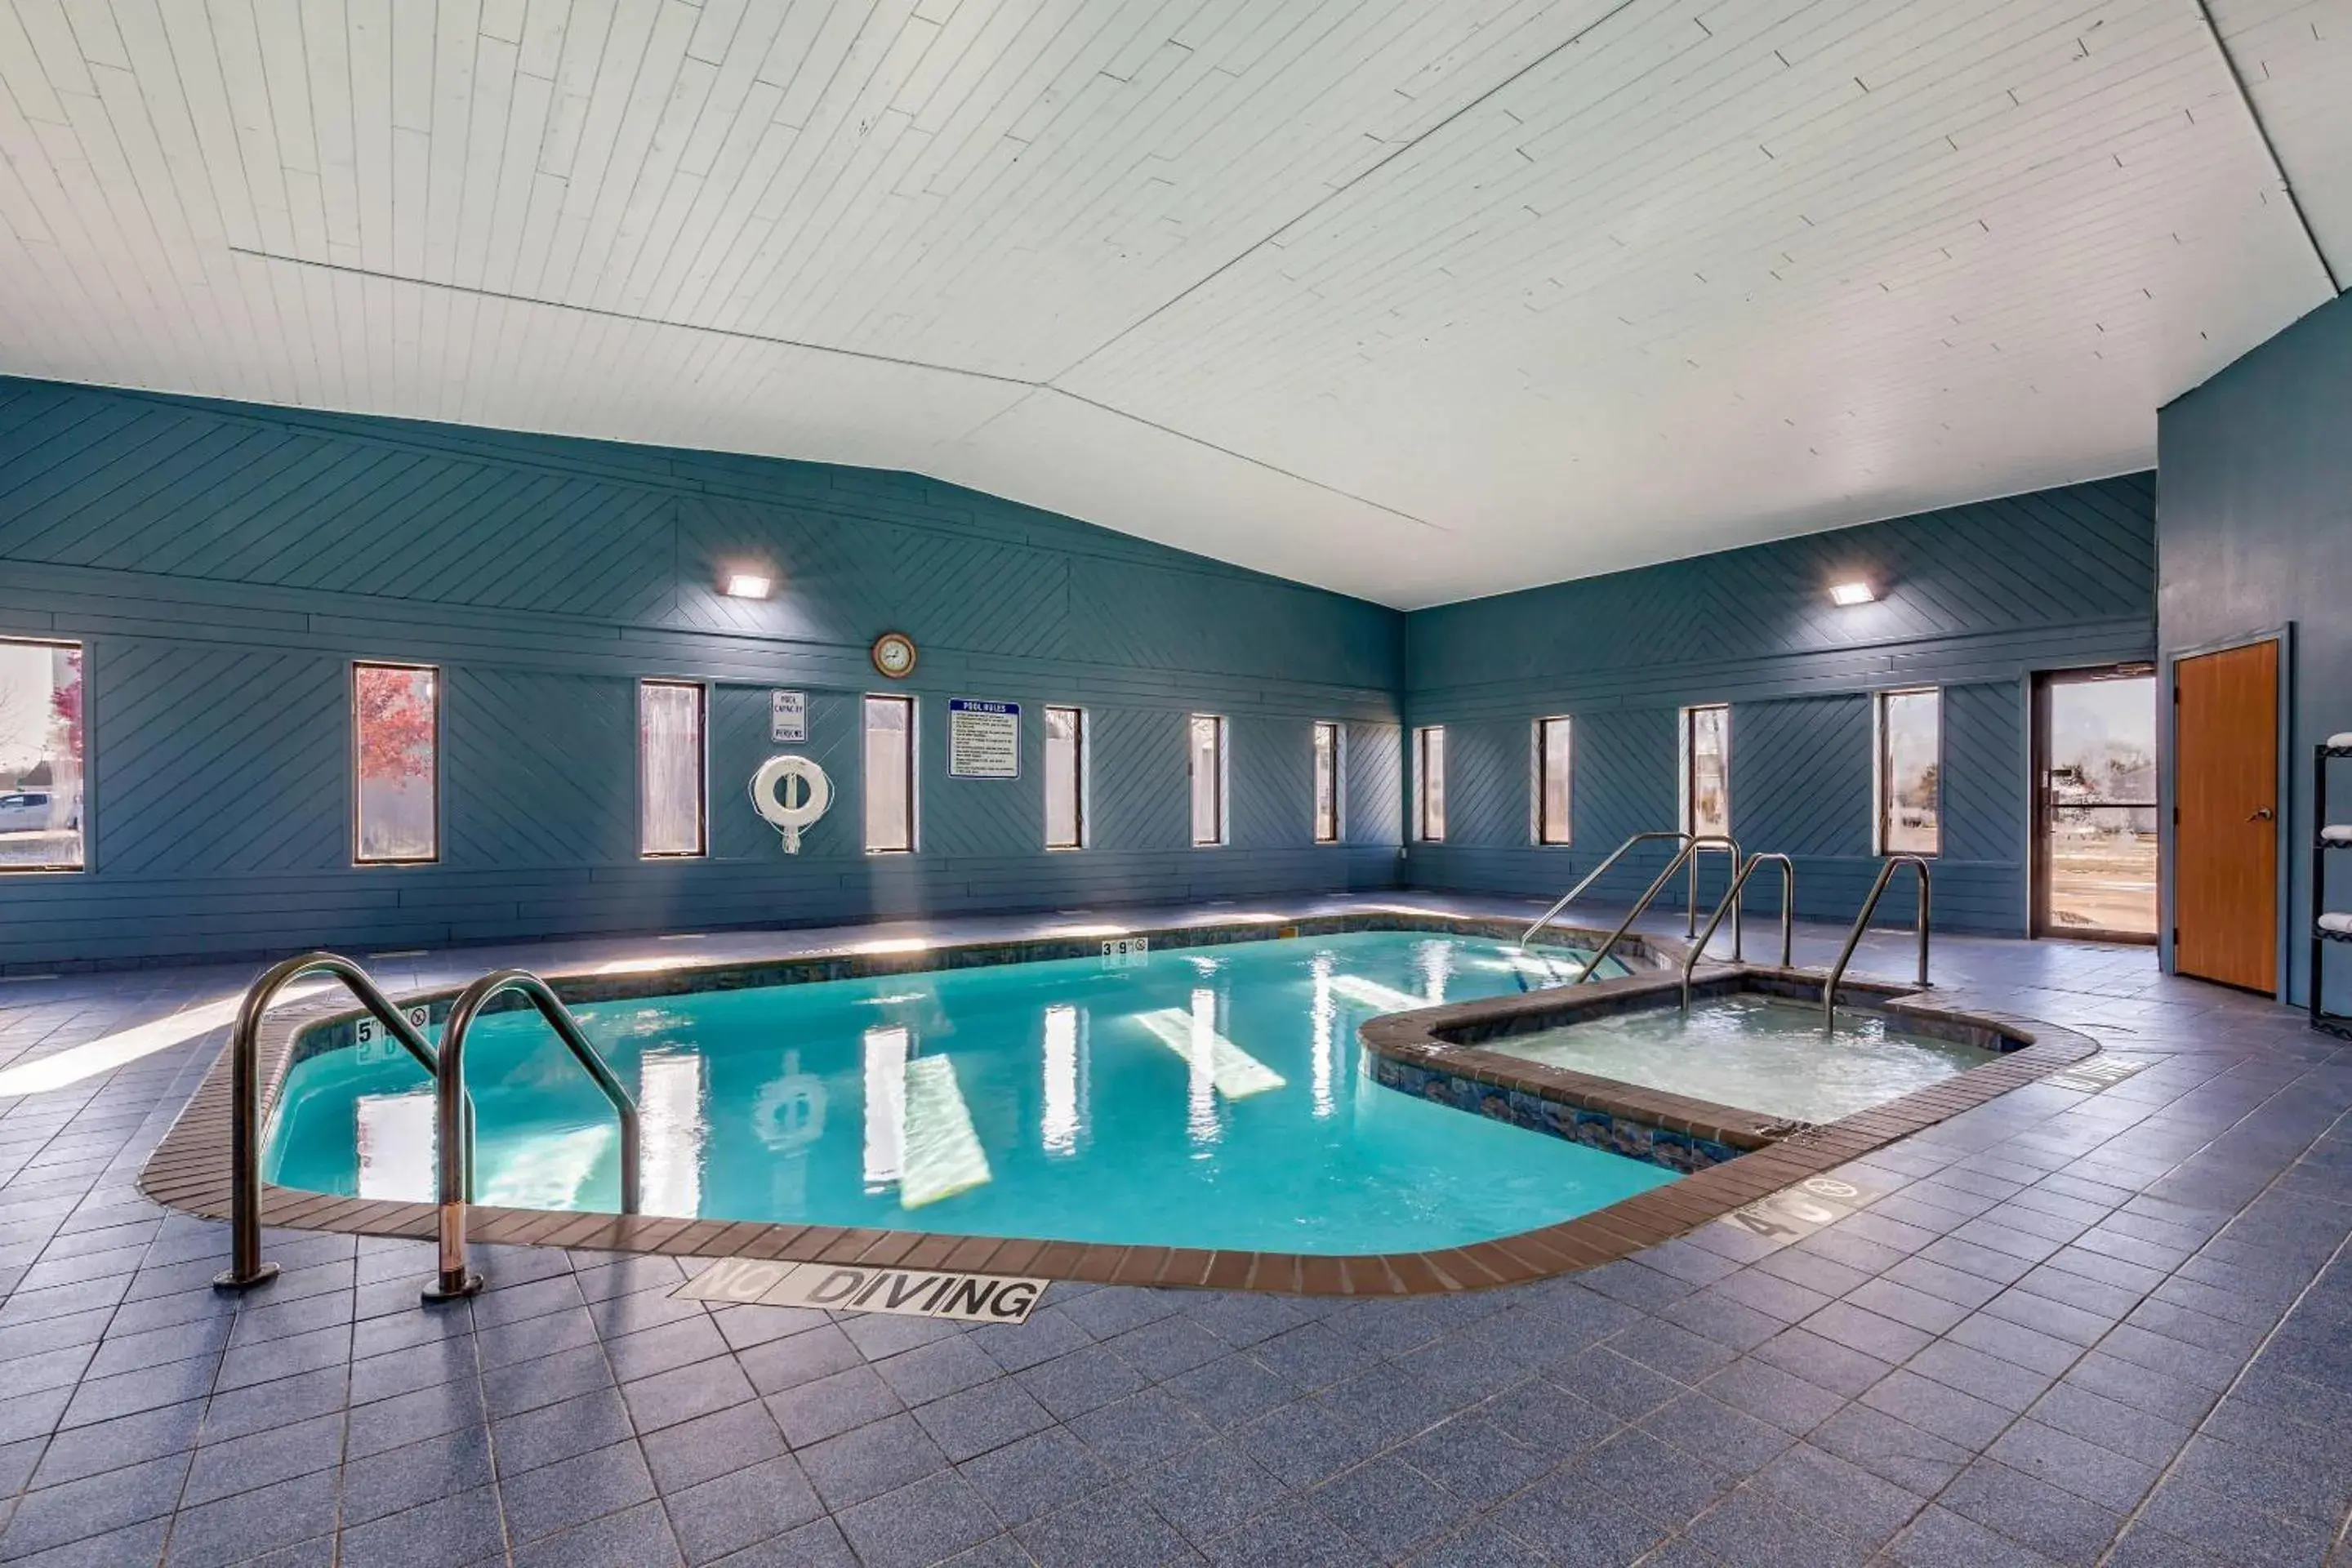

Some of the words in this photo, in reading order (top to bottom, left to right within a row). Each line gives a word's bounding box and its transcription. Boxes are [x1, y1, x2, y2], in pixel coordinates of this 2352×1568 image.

[963, 702, 982, 711] POOL
[982, 703, 1005, 713] RULES
[1102, 942, 1111, 956] 3
[1119, 942, 1127, 954] 9
[359, 1022, 372, 1042] 5
[1734, 1214, 1798, 1236] 4
[804, 1269, 1038, 1317] DIVING
